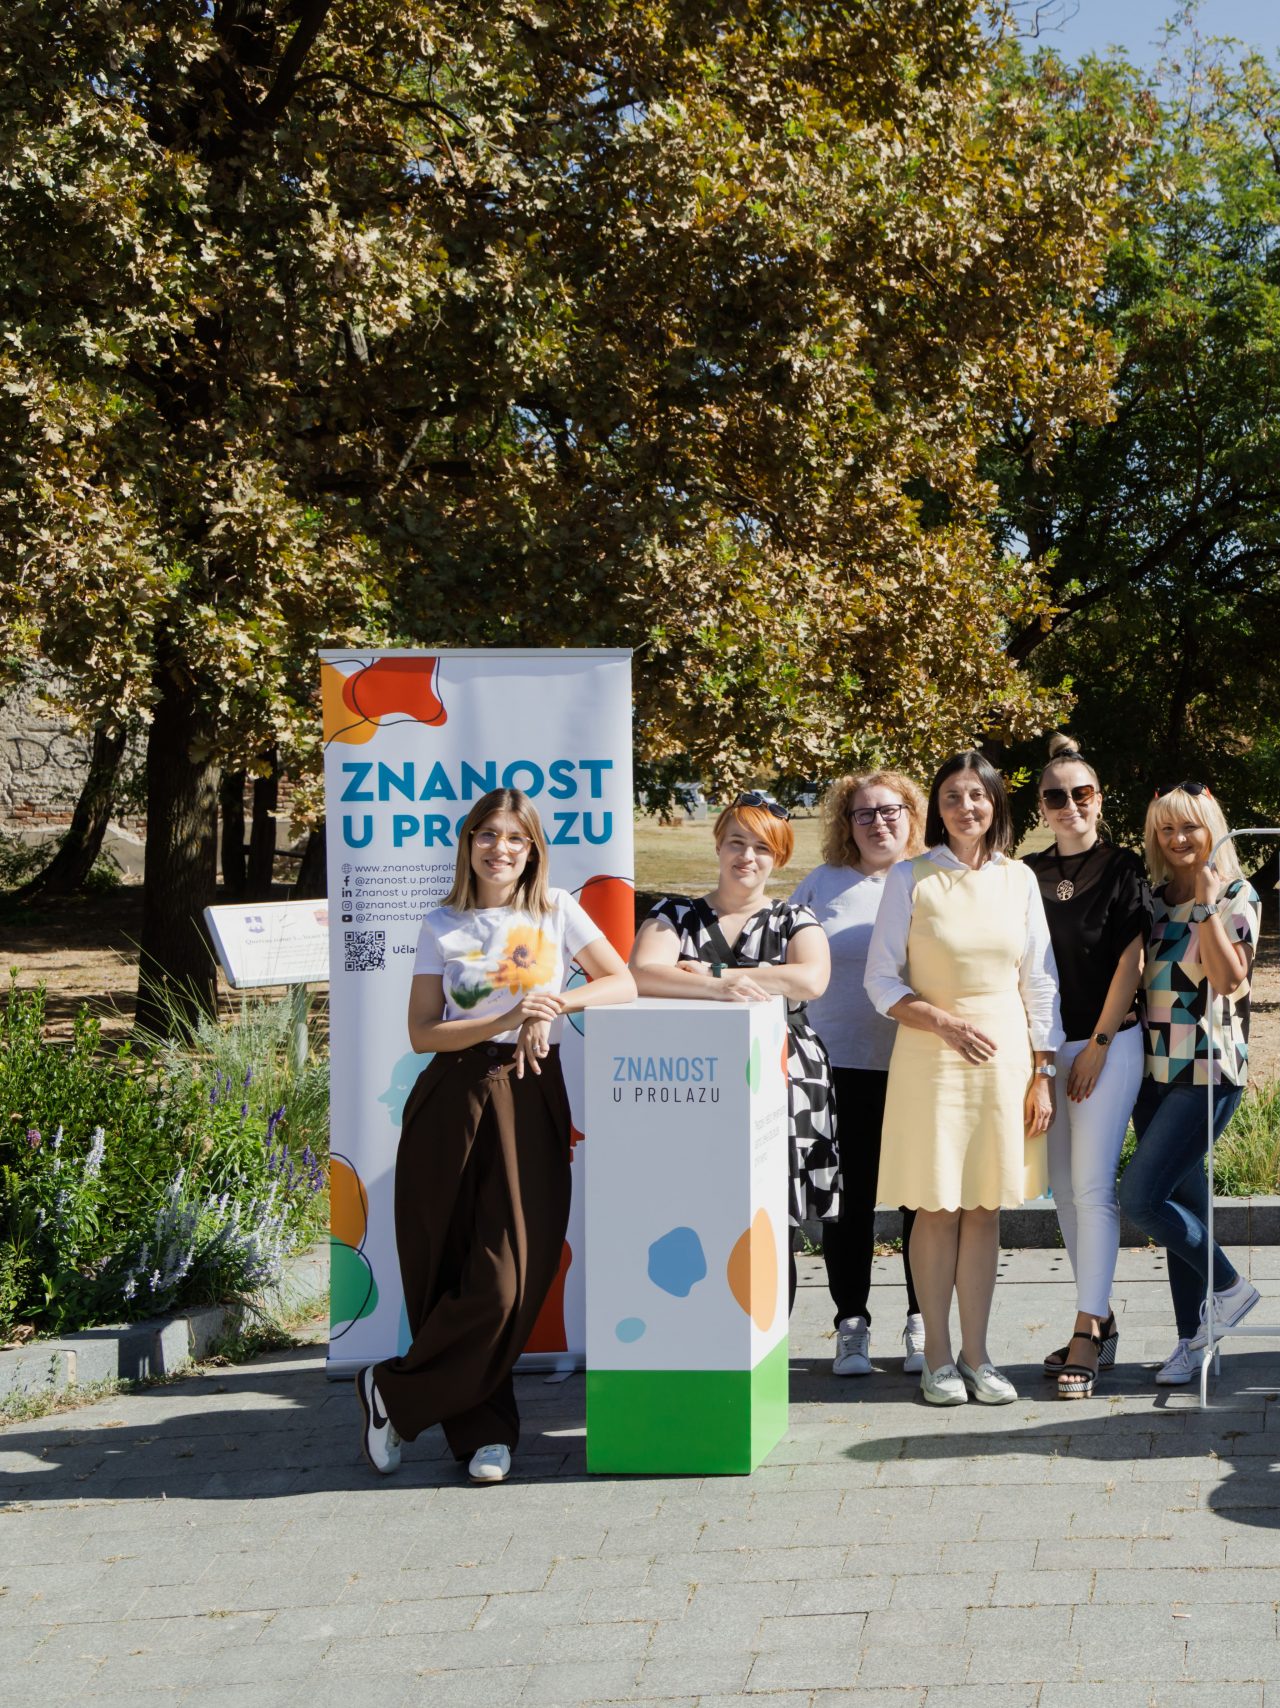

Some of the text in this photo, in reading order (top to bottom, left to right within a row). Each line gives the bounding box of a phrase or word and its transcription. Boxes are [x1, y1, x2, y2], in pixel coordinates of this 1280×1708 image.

[341, 759, 613, 802] ZNANOST
[342, 811, 613, 848] U PRZU
[355, 888, 398, 898] Znanost
[410, 887, 449, 899] prolazu
[392, 944, 418, 954] Učla
[613, 1056, 719, 1082] ZNANOST
[613, 1087, 720, 1103] U PROLAZU
